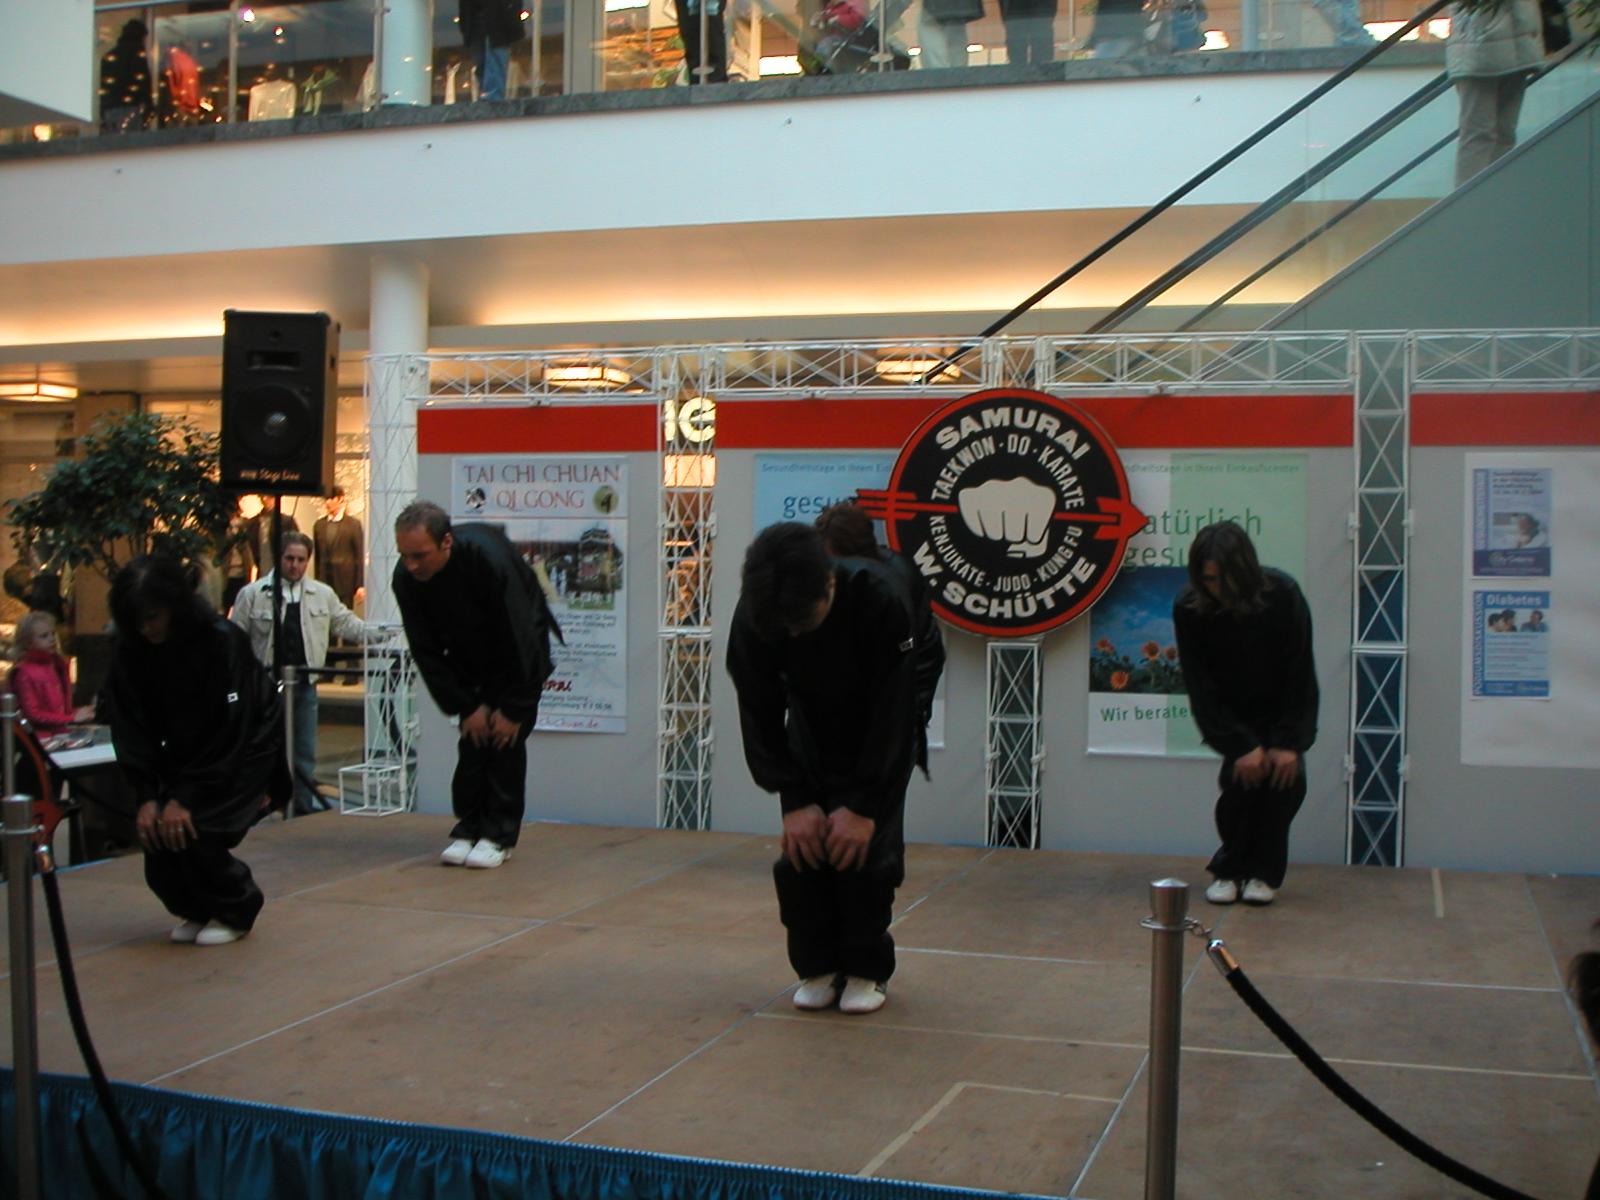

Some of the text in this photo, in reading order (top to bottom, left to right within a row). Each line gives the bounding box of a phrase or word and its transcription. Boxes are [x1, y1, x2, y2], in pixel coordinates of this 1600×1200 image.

[936, 407, 1091, 460] SAMURAI
[463, 464, 620, 484] TAI CHI CHUAN
[931, 434, 1085, 509] TAEKWON DO KARATE
[496, 490, 585, 511] QI GONG
[929, 515, 1084, 592] KENJUKATE JUDO KUNG FU
[942, 556, 1097, 619] SCHÜTTE
[1487, 594, 1542, 606] Diabetes
[1100, 705, 1188, 722] Wir berate
